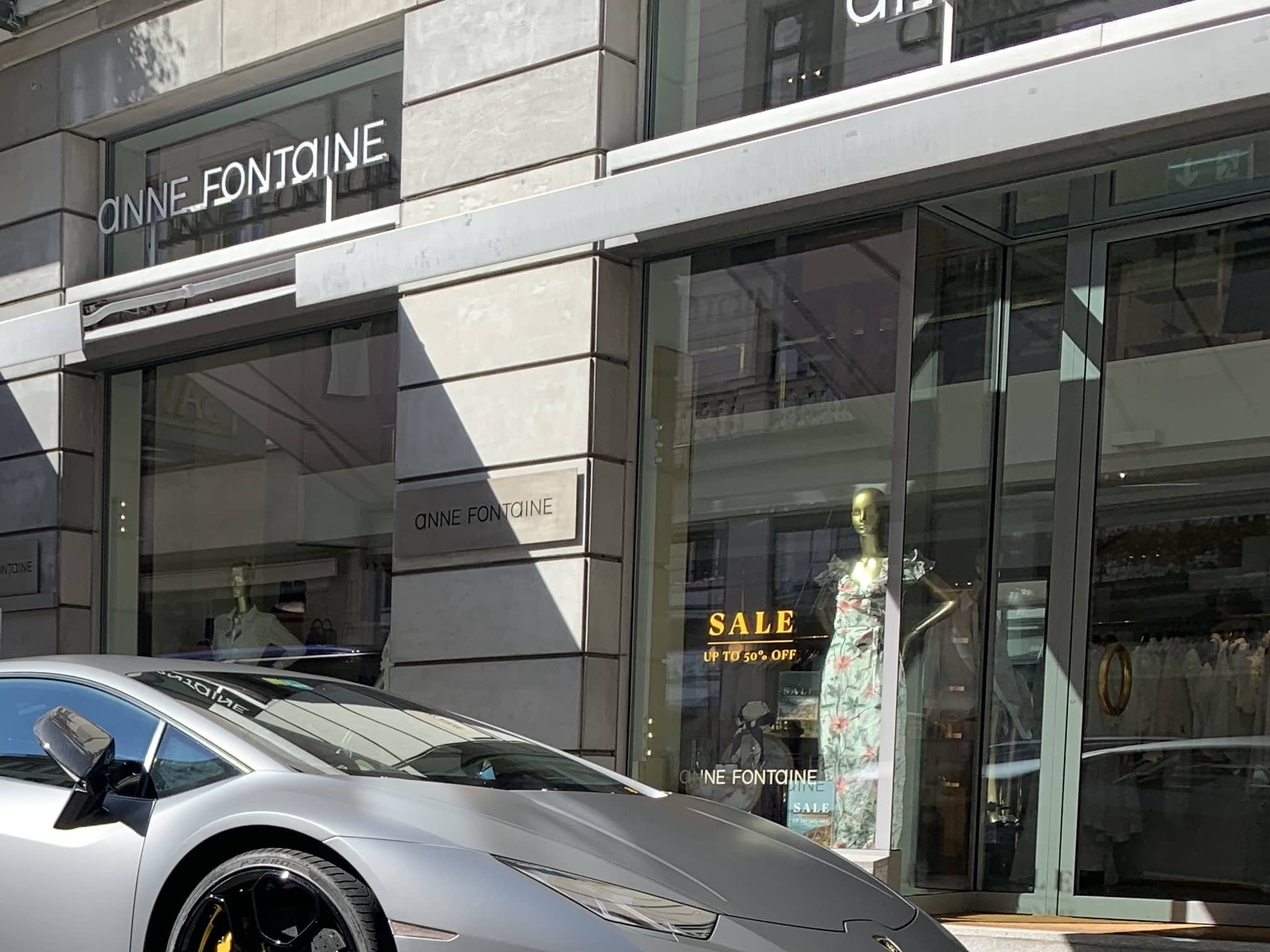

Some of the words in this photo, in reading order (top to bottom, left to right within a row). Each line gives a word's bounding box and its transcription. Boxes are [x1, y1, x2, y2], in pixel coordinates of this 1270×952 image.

[709, 610, 794, 637] SALE
[703, 651, 719, 664] UP
[723, 650, 740, 662] TO
[743, 649, 768, 663] 50%
[771, 649, 797, 661] OFF
[793, 802, 830, 813] SALE
